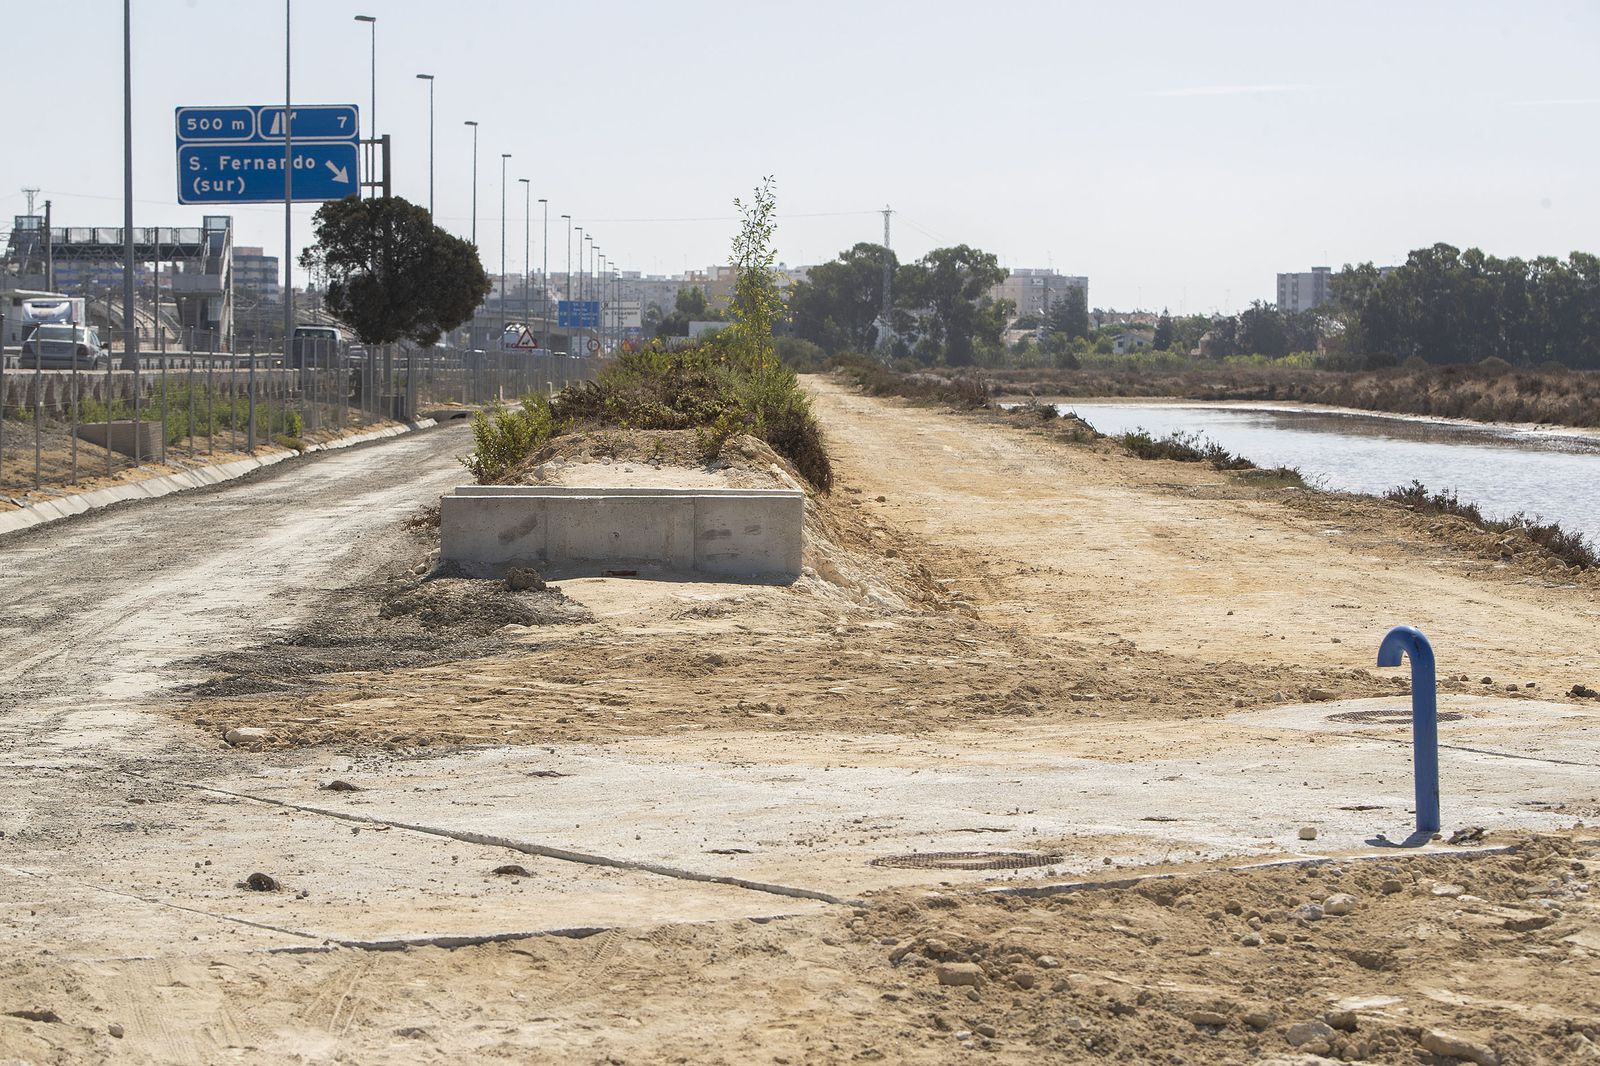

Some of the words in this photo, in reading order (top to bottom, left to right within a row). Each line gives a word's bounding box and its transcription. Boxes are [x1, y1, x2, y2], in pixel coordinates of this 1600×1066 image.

[187, 118, 223, 130] 500
[232, 120, 245, 130] m
[337, 116, 348, 129] 7
[189, 156, 208, 171] S.
[193, 176, 245, 195] (sur)
